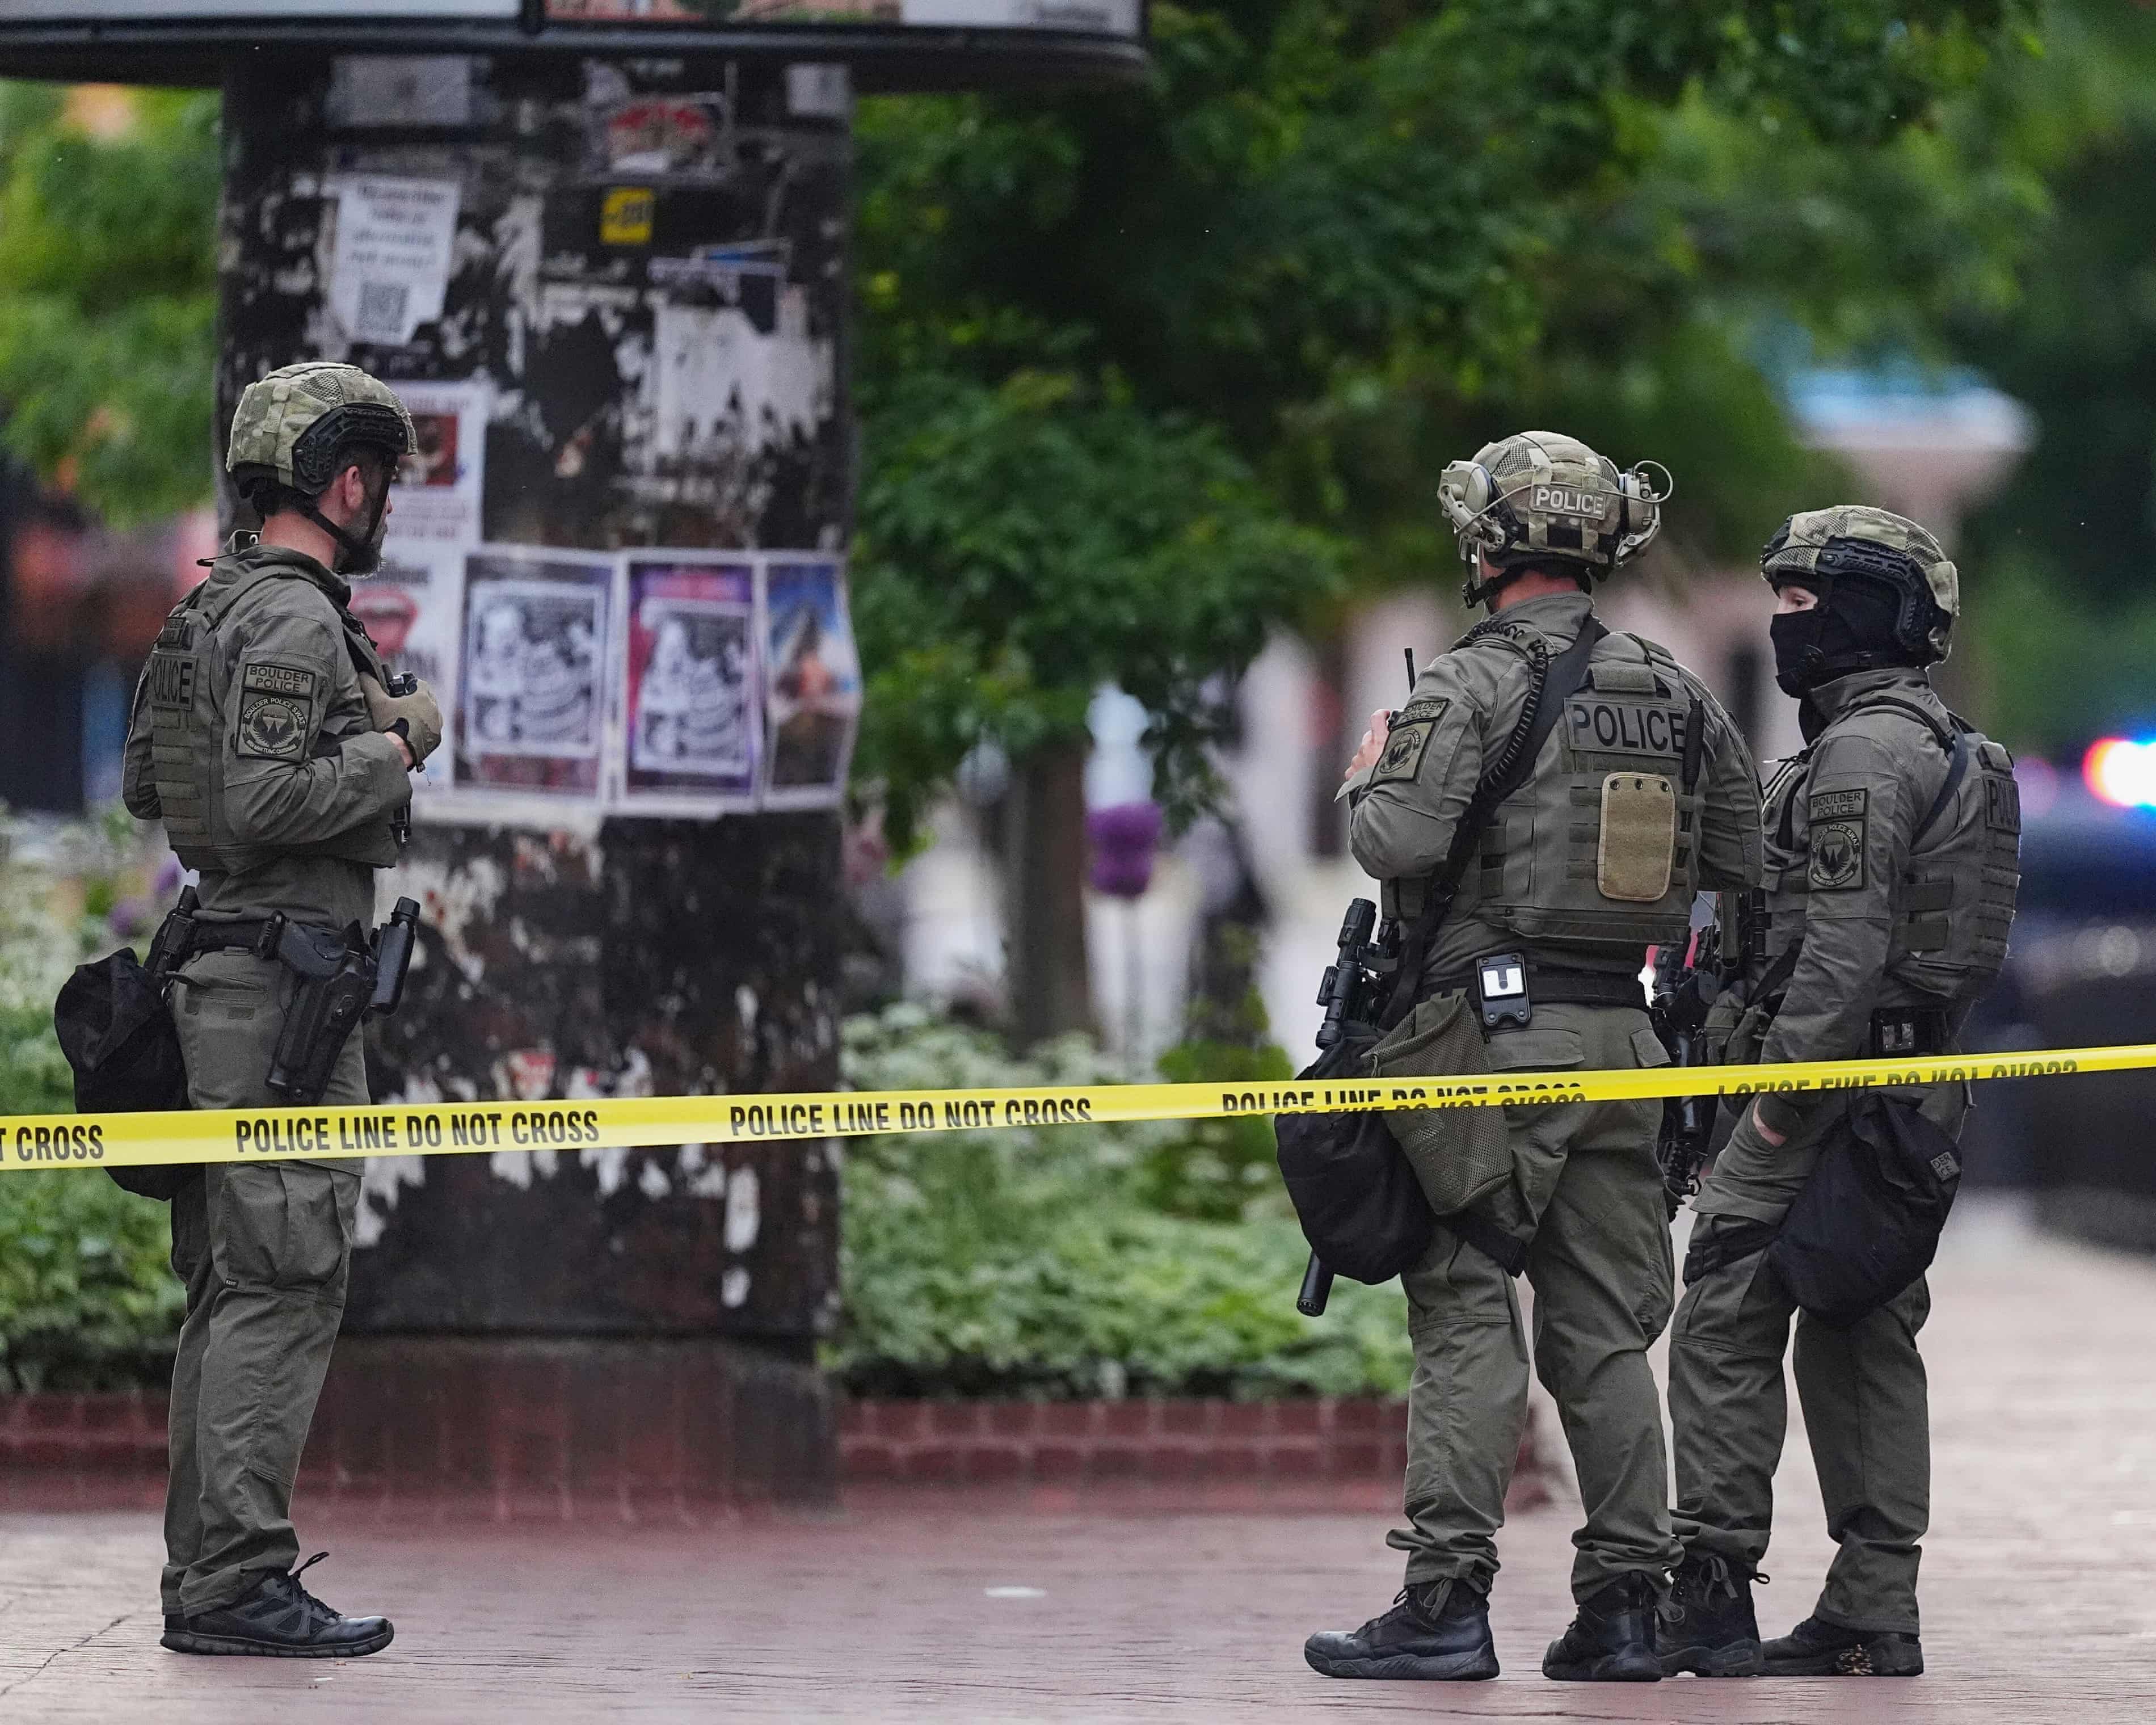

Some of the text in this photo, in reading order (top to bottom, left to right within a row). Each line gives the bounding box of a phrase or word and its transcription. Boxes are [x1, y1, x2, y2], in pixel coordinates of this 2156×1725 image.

[1536, 488, 1603, 515] POLICE
[250, 667, 309, 683] BOULDER
[256, 678, 300, 692] POLICE
[1572, 704, 1685, 753] POLICE
[1813, 792, 1861, 807] BOULDER
[1817, 803, 1854, 817] POLICE
[731, 1098, 1092, 1136] POLICE LINE DO NOT CROSS
[16, 1125, 104, 1161] CROSS
[236, 1110, 599, 1152] POLICE LINE DO NOT CROSS
